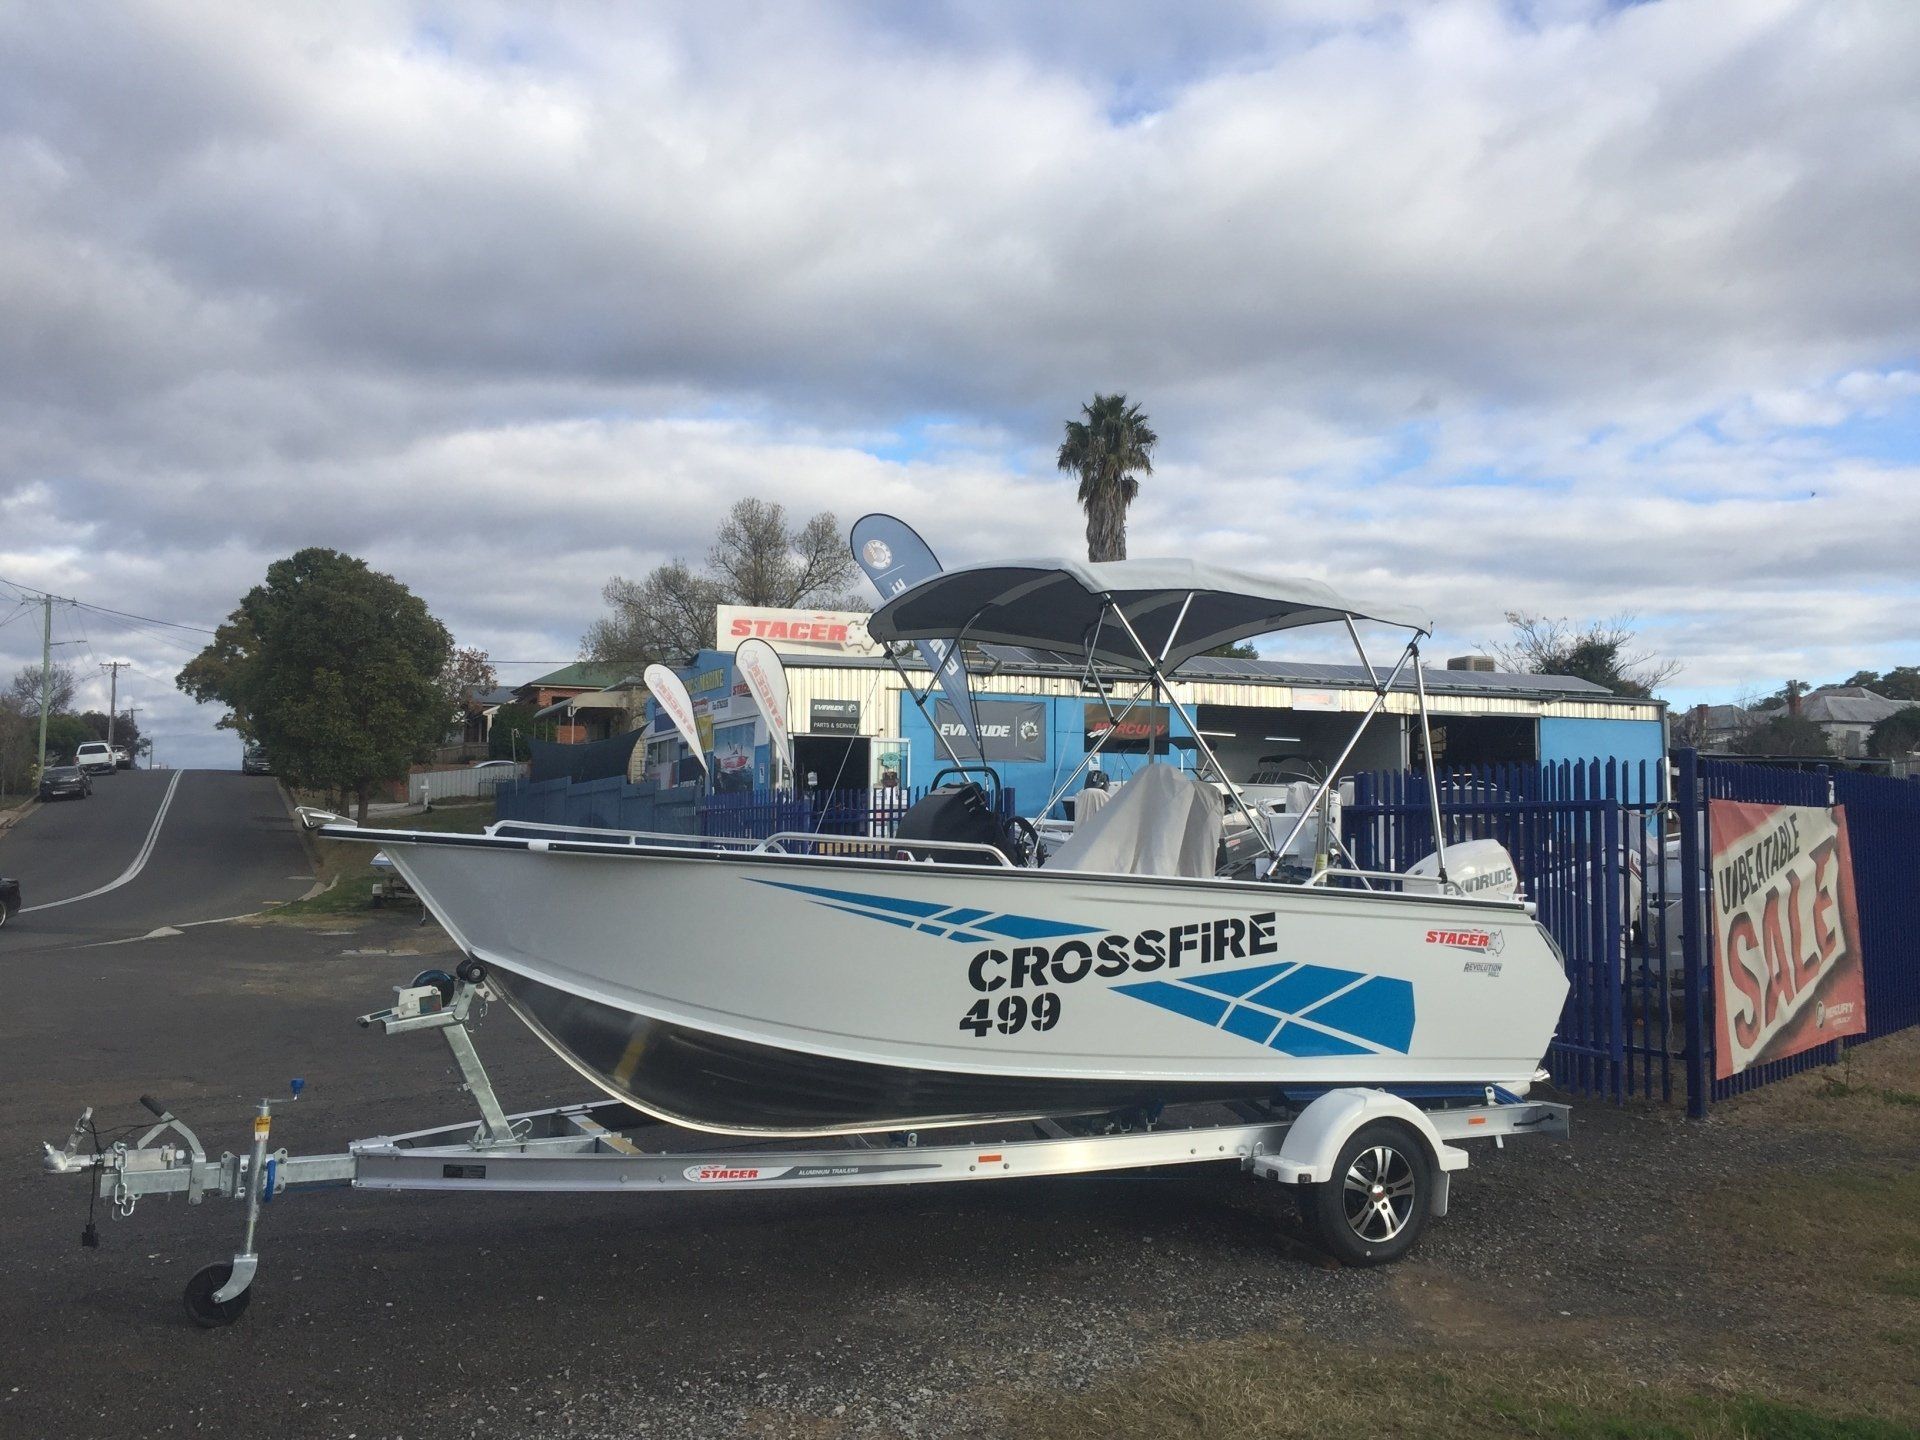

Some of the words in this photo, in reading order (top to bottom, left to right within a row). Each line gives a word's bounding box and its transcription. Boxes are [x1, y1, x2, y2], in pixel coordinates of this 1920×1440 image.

[730, 619, 848, 641] STACER
[836, 722, 857, 730] SERVICE
[941, 723, 1011, 738] EVIUDE
[1089, 721, 1165, 737] MRCUY
[1719, 813, 1800, 915] UNBEATABLE
[1426, 931, 1490, 947] STACER
[1727, 834, 1837, 1050] SALE
[1463, 962, 1502, 973] REVOLUTION
[959, 992, 1061, 1038] 499
[700, 1169, 758, 1179] STACER
